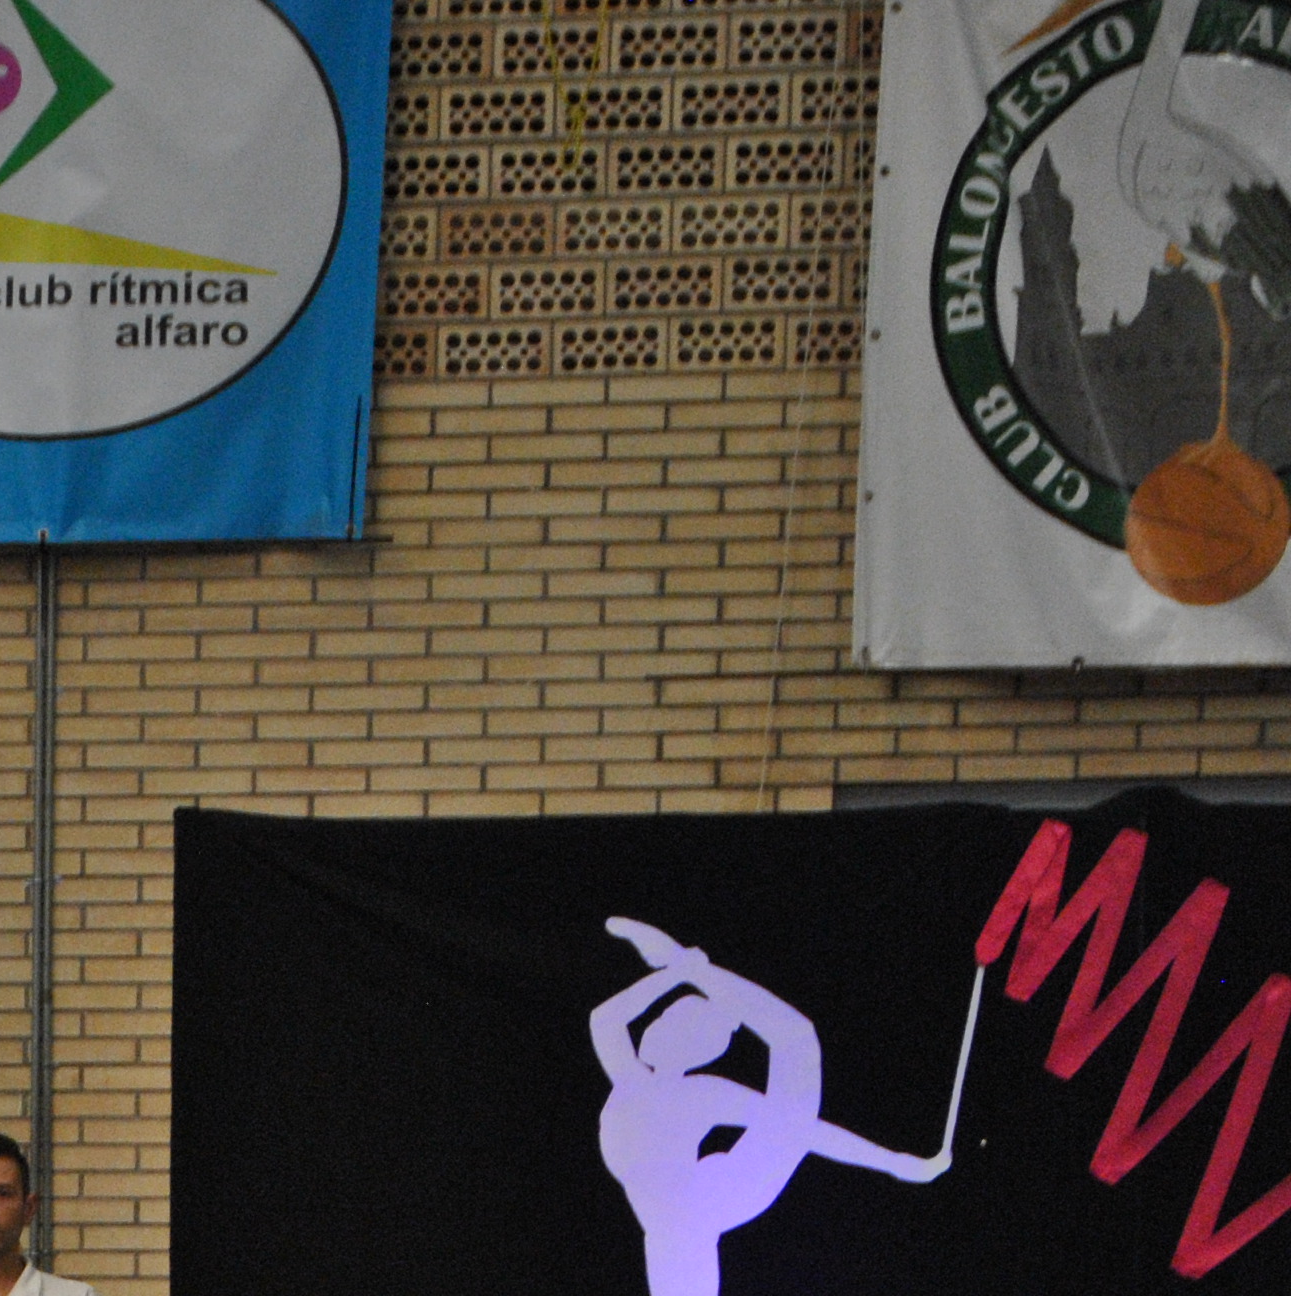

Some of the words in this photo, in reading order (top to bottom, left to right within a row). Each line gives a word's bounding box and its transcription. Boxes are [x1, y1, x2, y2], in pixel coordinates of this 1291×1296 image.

[89, 271, 249, 305] rítmica
[115, 313, 249, 347] alfaro
[973, 385, 1090, 511] CLUB
